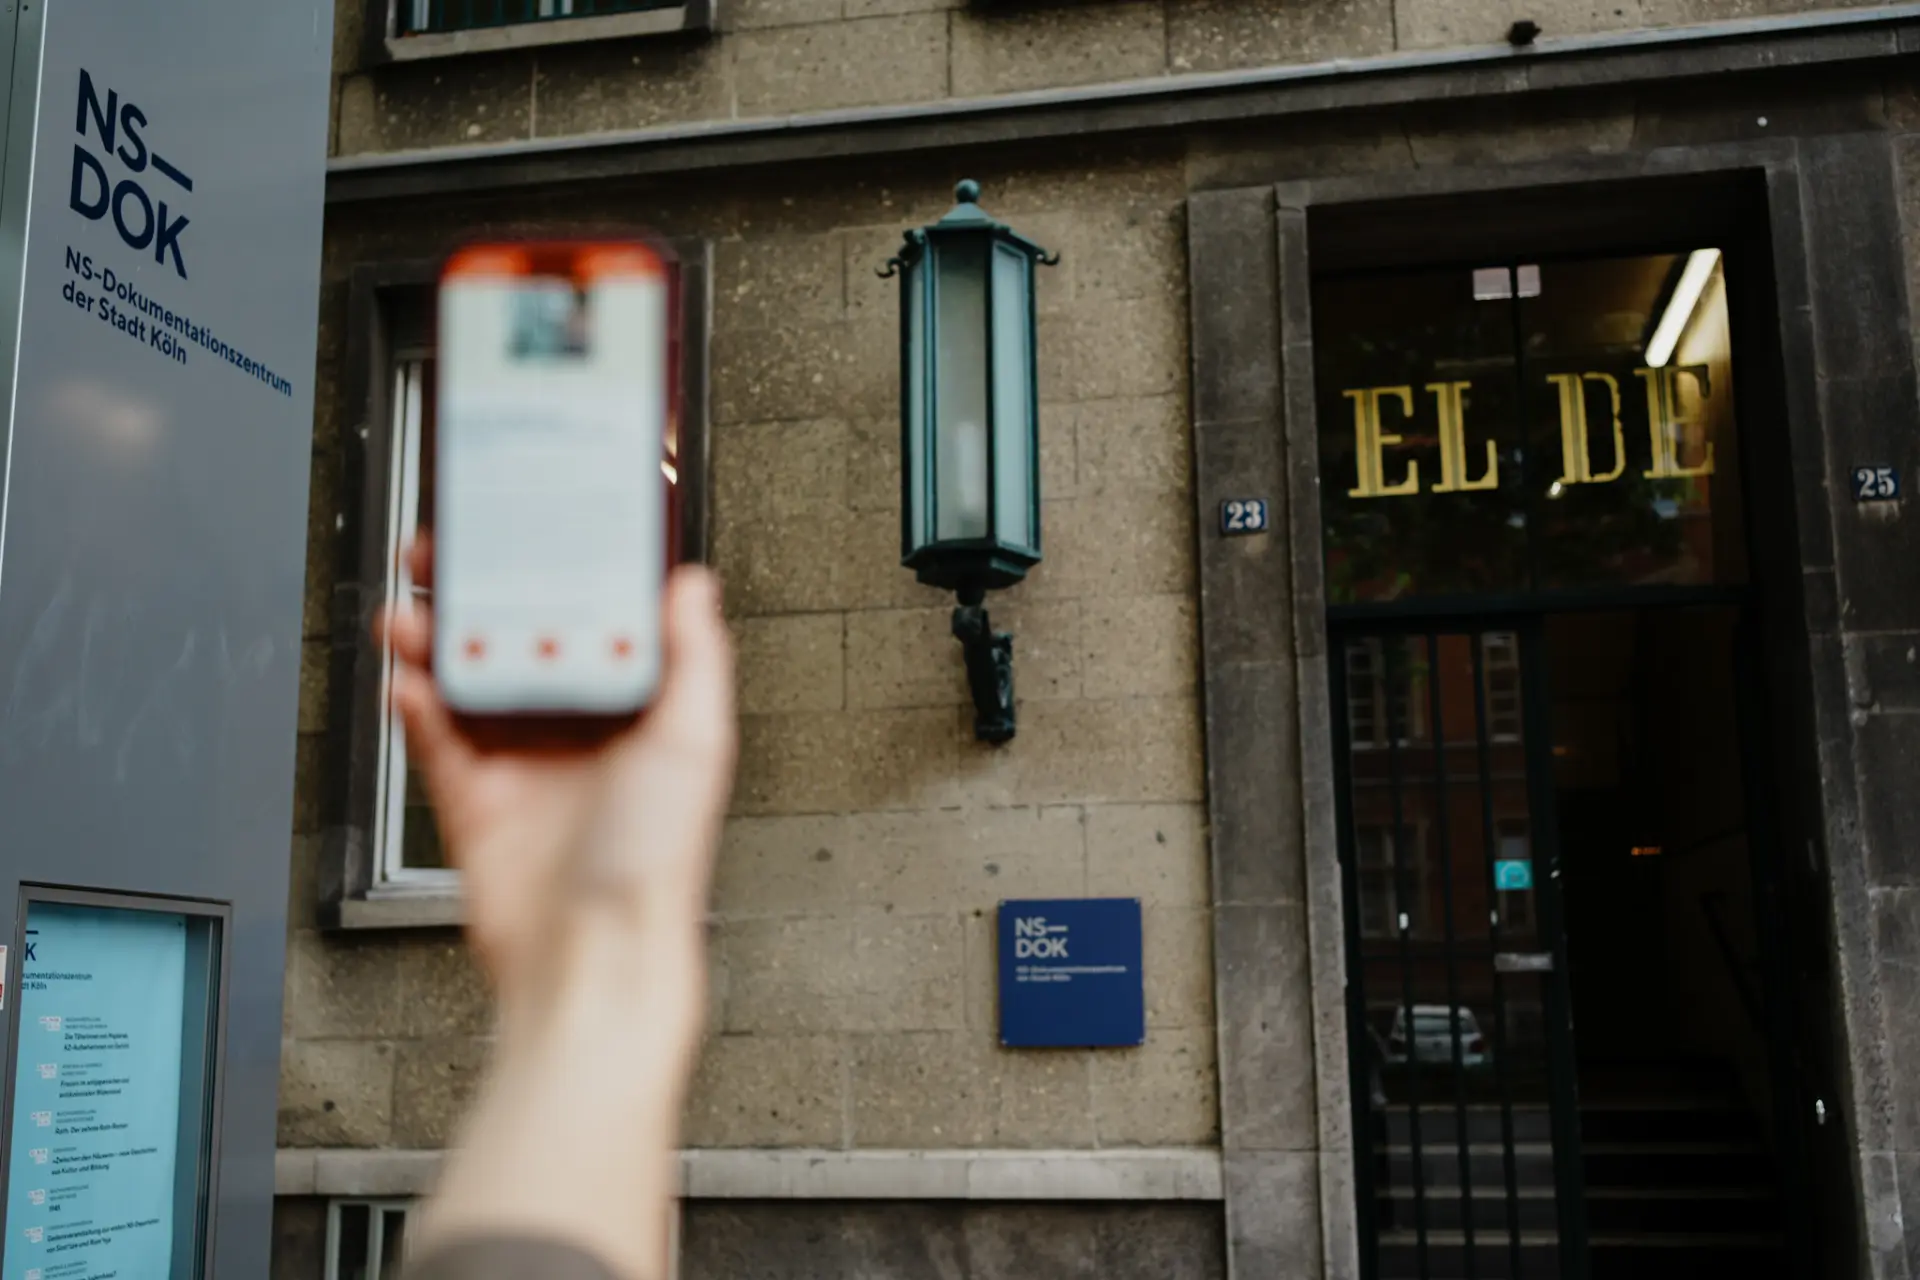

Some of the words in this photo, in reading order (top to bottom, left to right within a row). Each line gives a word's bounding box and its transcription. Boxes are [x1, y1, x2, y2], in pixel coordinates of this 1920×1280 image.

[70, 143, 191, 280] DOK
[62, 280, 95, 312] der
[98, 297, 146, 343] Stadt
[150, 324, 187, 365] Köln
[65, 245, 293, 397] NS-Dokumentationszentrum
[1342, 381, 1499, 498] EL
[1545, 363, 1715, 485] DE
[1227, 500, 1262, 529] 23
[1857, 467, 1895, 497] 25
[1015, 937, 1069, 958] DOK
